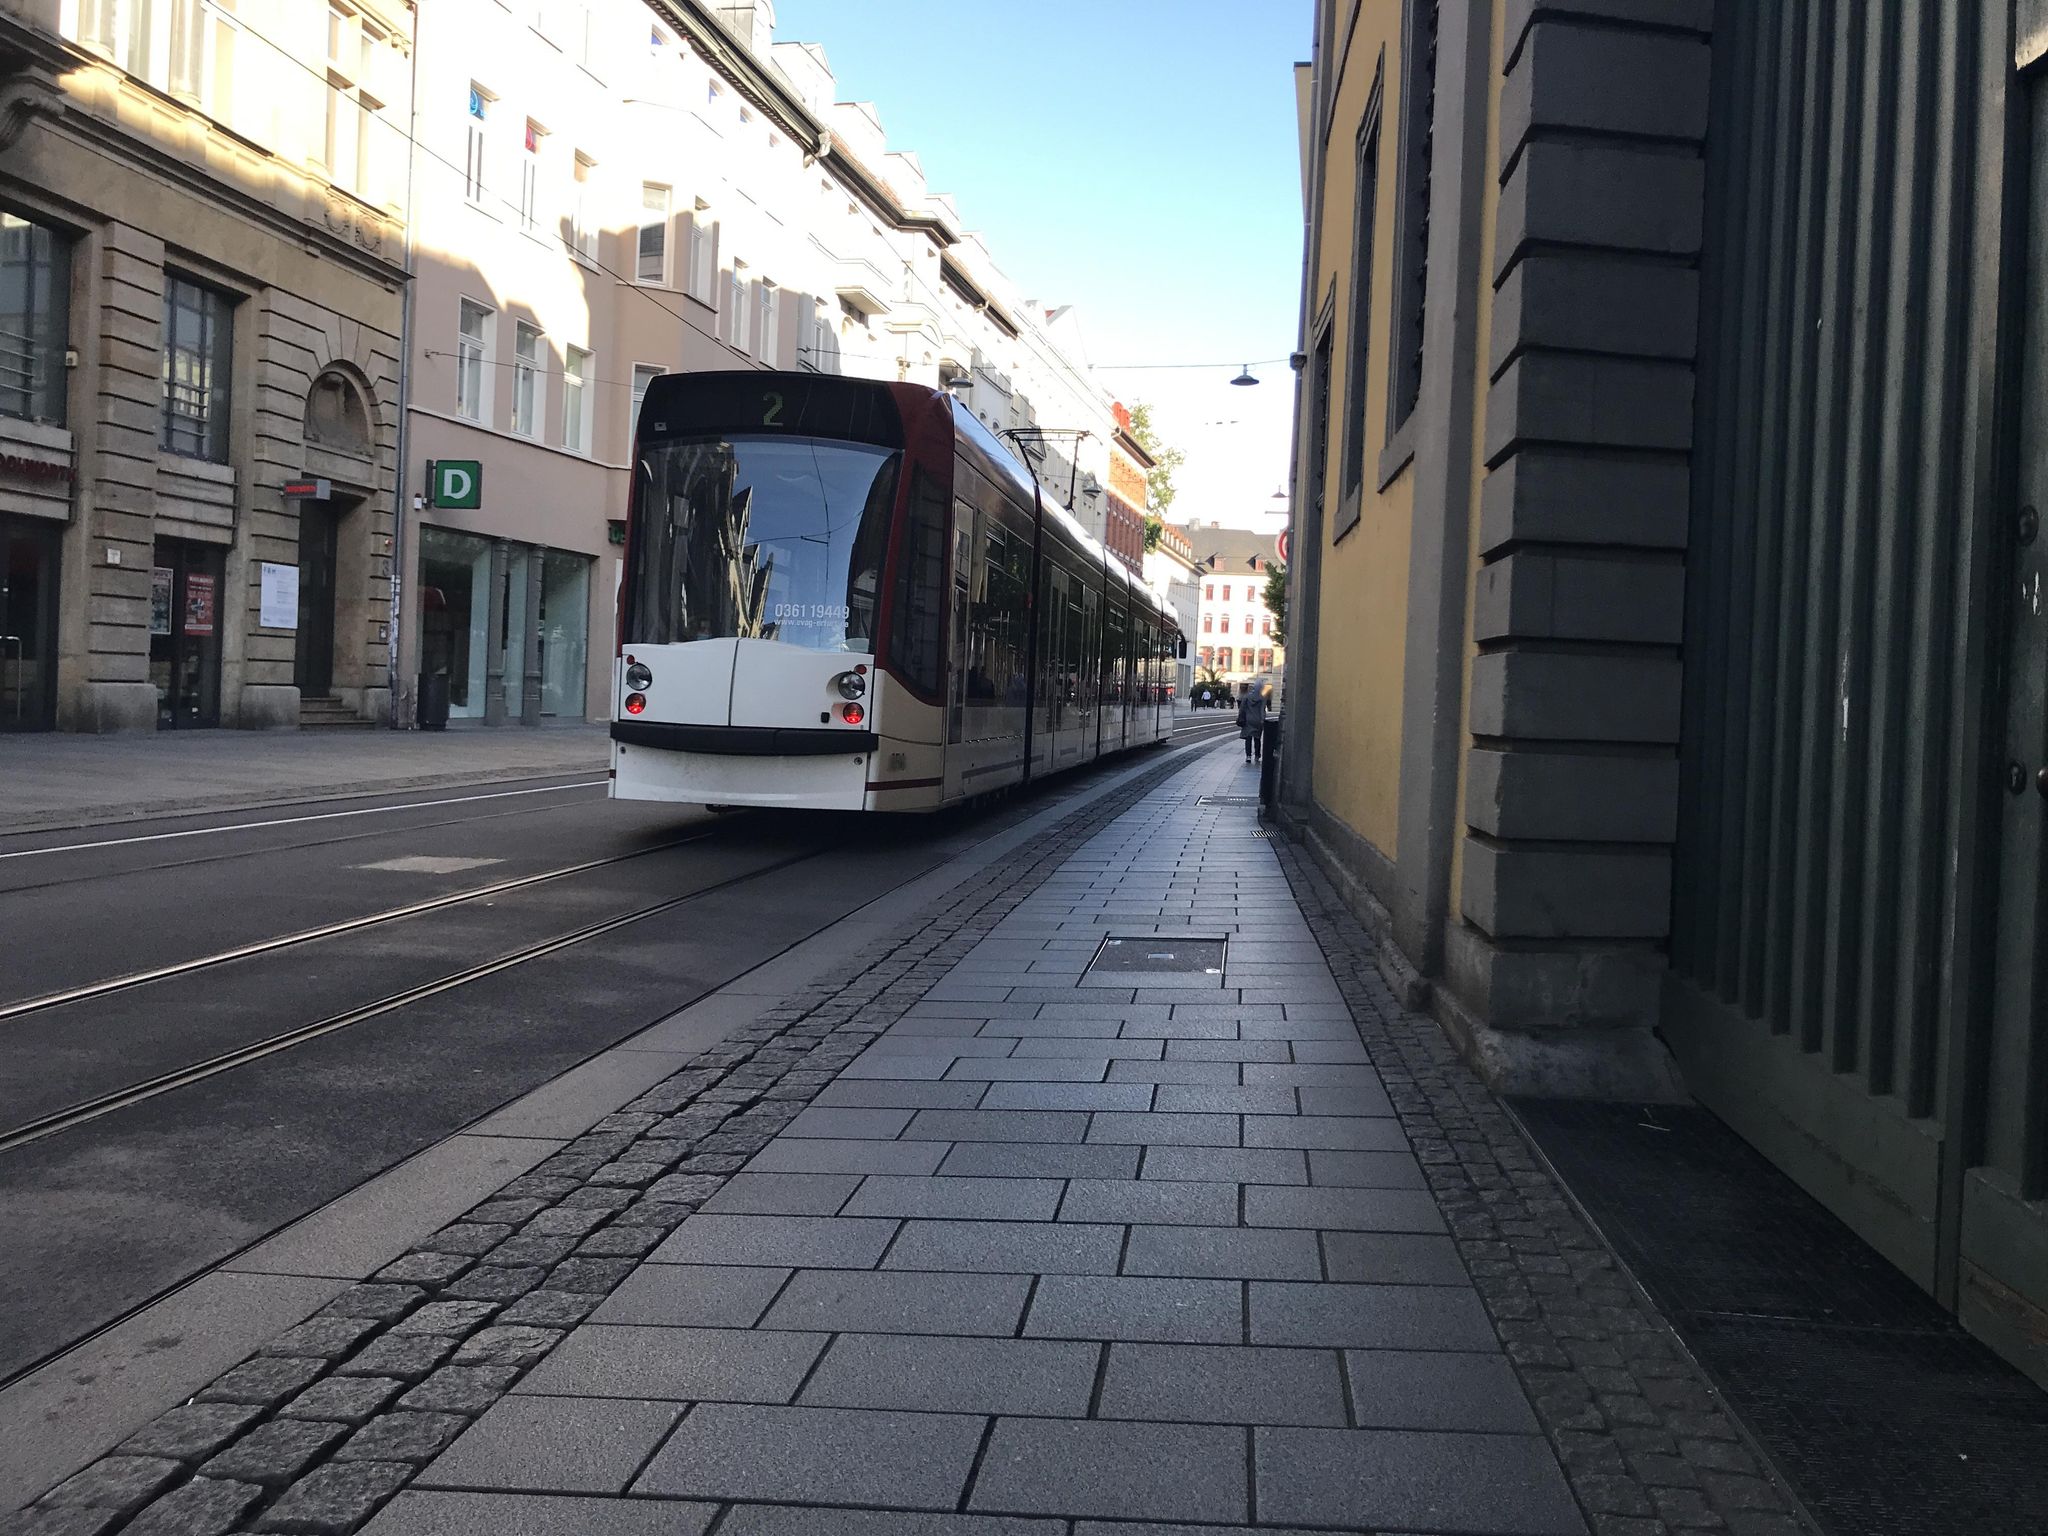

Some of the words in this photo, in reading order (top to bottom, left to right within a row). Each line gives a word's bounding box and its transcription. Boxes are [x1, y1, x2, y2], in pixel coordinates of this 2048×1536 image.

[763, 392, 783, 426] 2
[443, 469, 472, 500] D
[774, 619, 849, 628] www.evag-erfue
[775, 603, 806, 618] 0361
[810, 604, 850, 620] 19449
